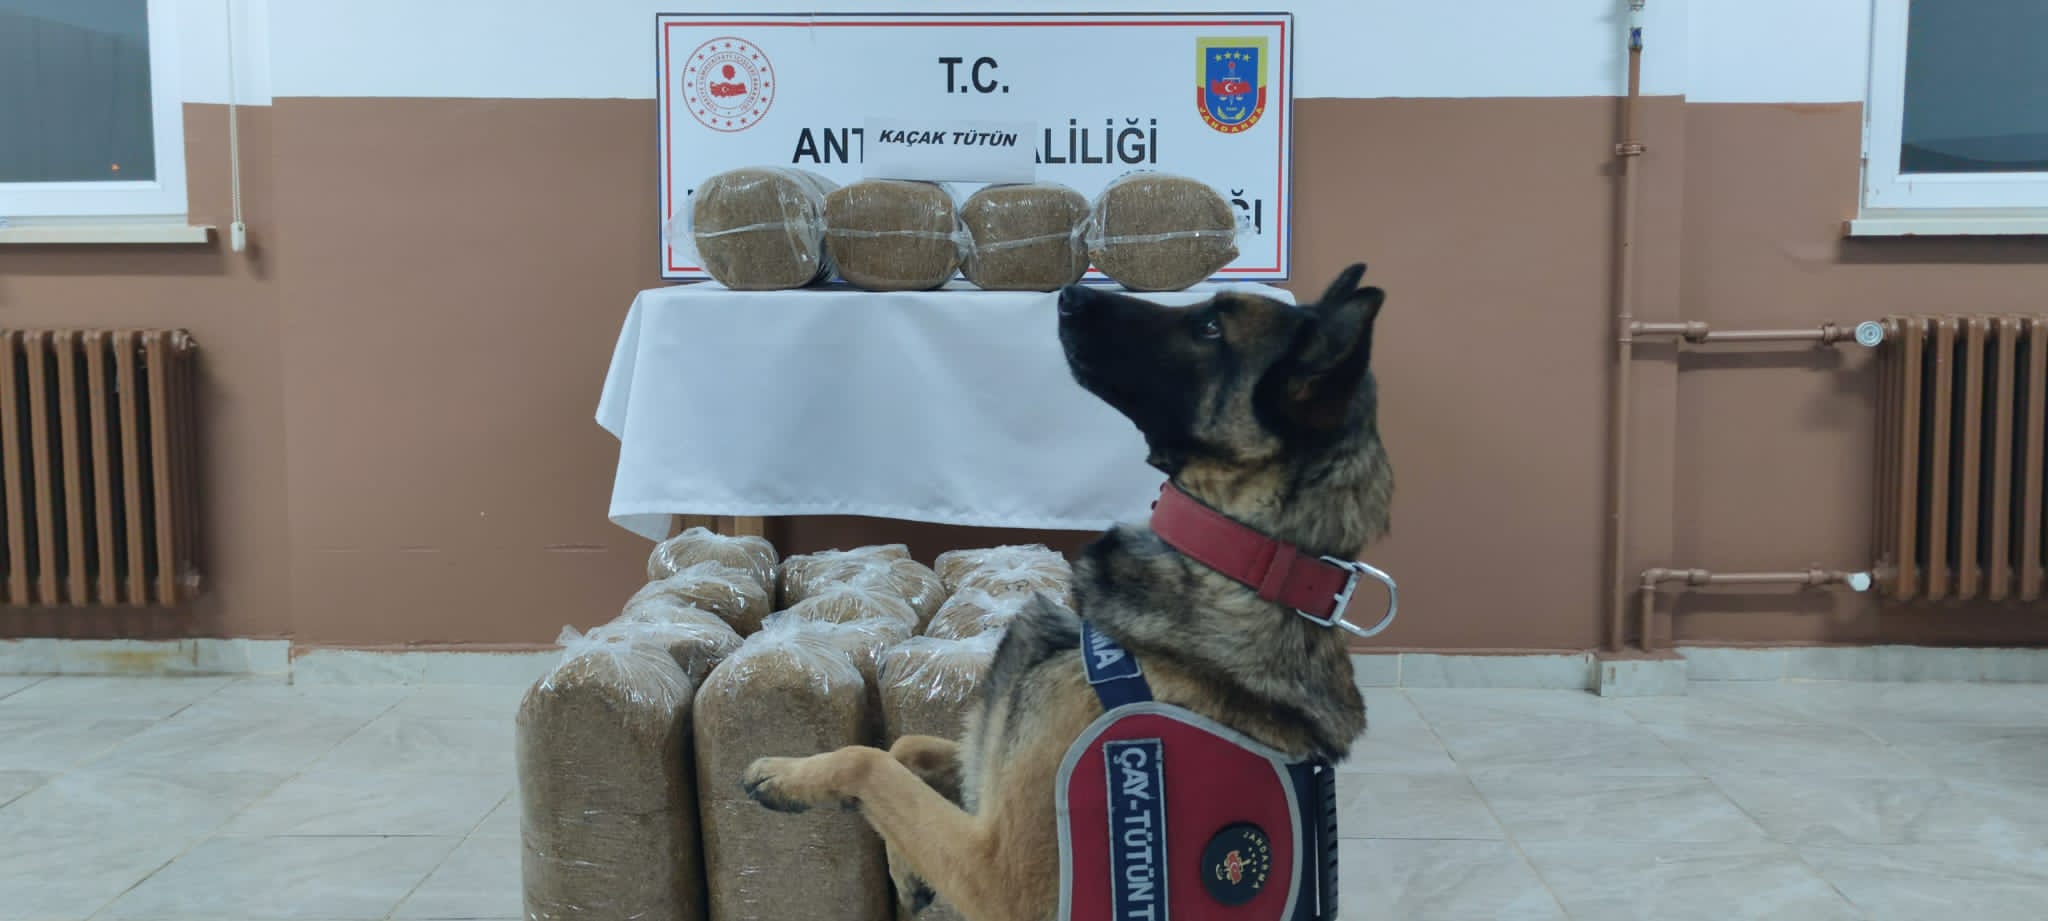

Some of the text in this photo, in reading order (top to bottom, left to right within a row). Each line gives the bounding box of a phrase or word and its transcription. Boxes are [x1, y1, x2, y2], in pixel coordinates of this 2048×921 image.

[938, 56, 1009, 94] T.C.
[879, 129, 1018, 148] KAÇAK TÜTÜN
[1199, 107, 1263, 133] JANDARMA
[1035, 118, 1157, 164] LİLİĞİ
[1113, 746, 1155, 902] ÇAY-TÜTÜN
